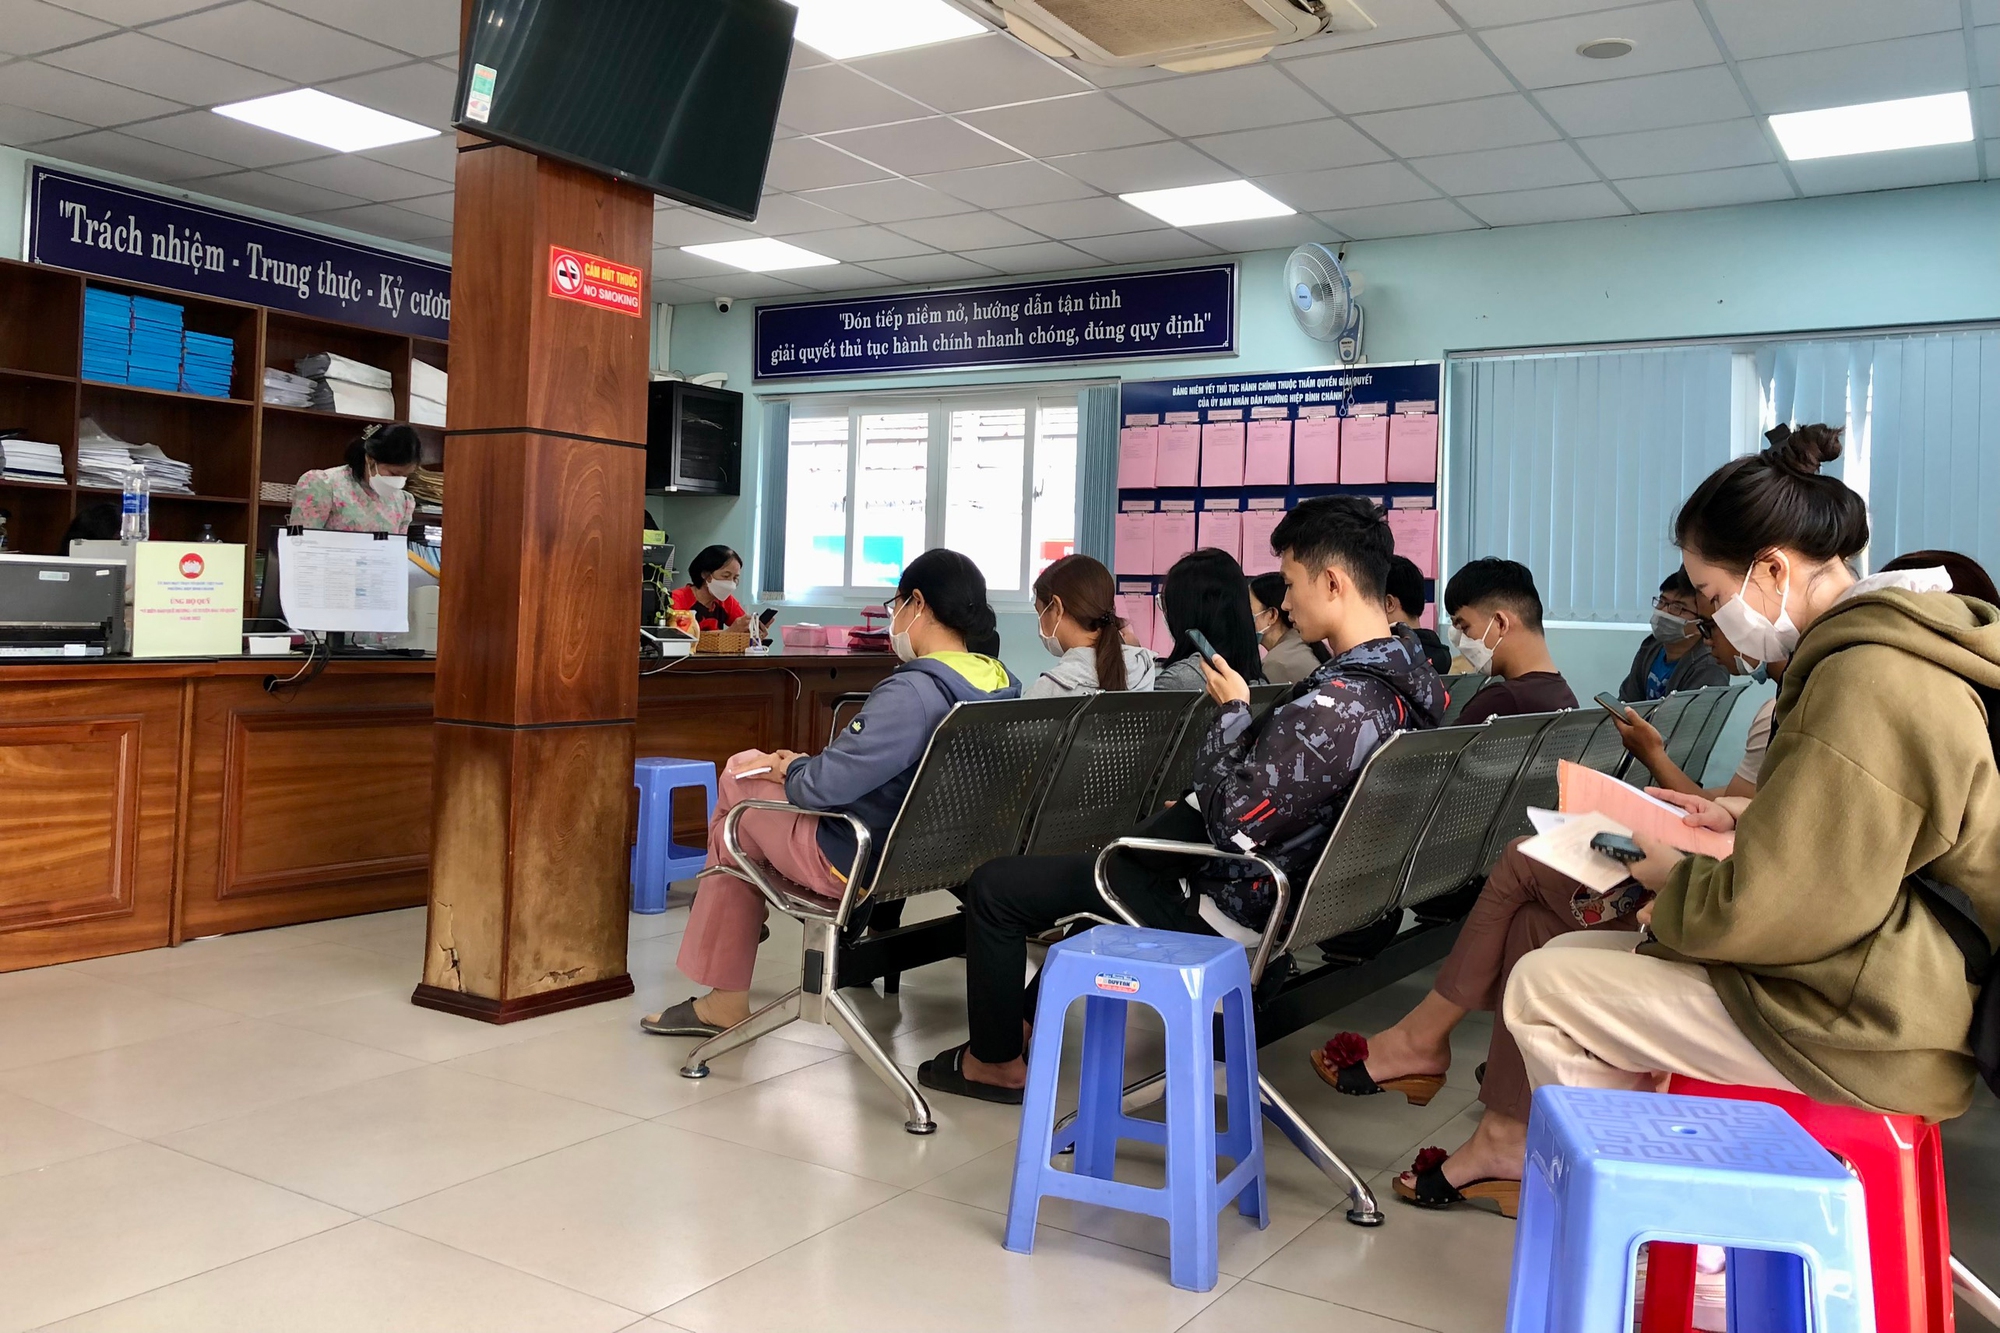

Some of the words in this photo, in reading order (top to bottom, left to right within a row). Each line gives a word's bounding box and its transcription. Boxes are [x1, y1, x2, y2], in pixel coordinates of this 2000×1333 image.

[59, 199, 143, 256] "Trách
[151, 224, 225, 275] nhiệm
[246, 242, 312, 299] Trung
[317, 260, 361, 307] thực
[378, 274, 404, 318] Kỷ
[410, 288, 450, 320] cươn
[585, 261, 600, 278] CẤM
[601, 266, 615, 282] HÚT
[616, 271, 638, 288] THUỐC
[583, 284, 597, 297] NO
[598, 289, 638, 307] SMOKING
[839, 312, 872, 331] "Đón
[875, 307, 902, 331] tiếp
[906, 303, 942, 325] niềm
[946, 303, 969, 325] nở,
[973, 300, 1020, 322] hướng
[1024, 293, 1053, 316] dẫn
[1058, 294, 1084, 316] tận
[1089, 289, 1122, 310] tình
[771, 343, 796, 366] giải
[799, 339, 836, 363] quyết
[840, 338, 863, 358] thủ
[866, 341, 889, 360] tục
[892, 334, 928, 354] hành
[932, 331, 973, 352] chính
[977, 328, 1024, 348] nhanh
[1028, 325, 1080, 346] chóng,
[1084, 321, 1126, 343] đúng
[1130, 322, 1160, 341] quy
[1165, 312, 1212, 339] định"
[1172, 385, 1188, 396] BẢNG
[1189, 384, 1204, 395] NIÊM
[1205, 382, 1215, 394] YẾT
[1216, 381, 1227, 394] THỦ
[1228, 383, 1240, 395] TỤC
[1240, 381, 1257, 392] HÀNH
[1258, 379, 1277, 391] CHÍNH
[1277, 378, 1297, 391] THUỘC
[1197, 396, 1210, 408] CỦA
[1219, 397, 1232, 407] BAN
[1232, 395, 1250, 406] NHÂN
[1250, 394, 1263, 405] DÂN
[1263, 392, 1288, 405] PHƯỜNG
[1289, 391, 1304, 404] HIỆP
[1304, 390, 1320, 402] BÌNH
[1321, 389, 1343, 401] CHÁNH
